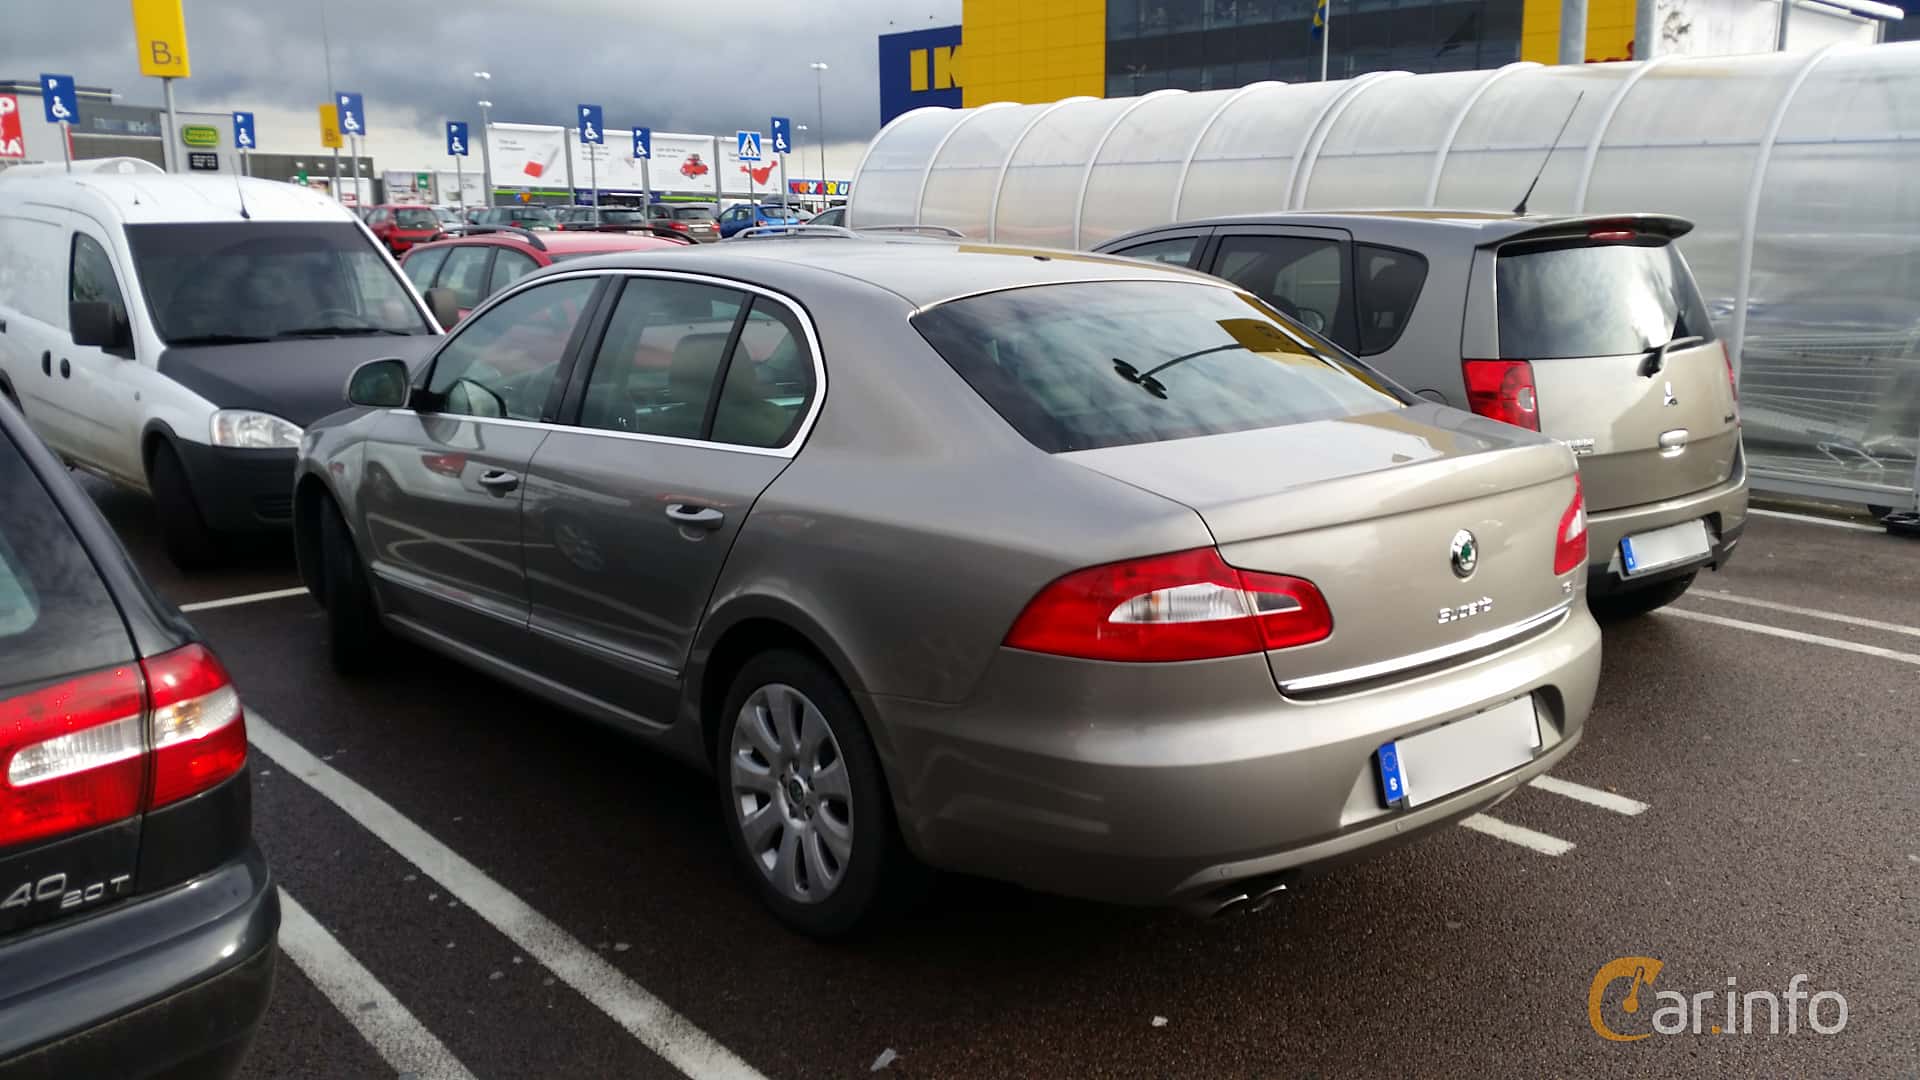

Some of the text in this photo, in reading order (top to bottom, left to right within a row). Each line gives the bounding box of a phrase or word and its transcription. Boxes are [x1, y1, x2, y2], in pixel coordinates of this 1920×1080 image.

[910, 45, 962, 92] IK
[48, 79, 58, 90] P
[341, 95, 350, 105] P
[583, 108, 591, 117] P
[236, 114, 244, 123] P
[450, 124, 458, 133] P
[774, 120, 781, 128] P
[635, 129, 642, 137] P
